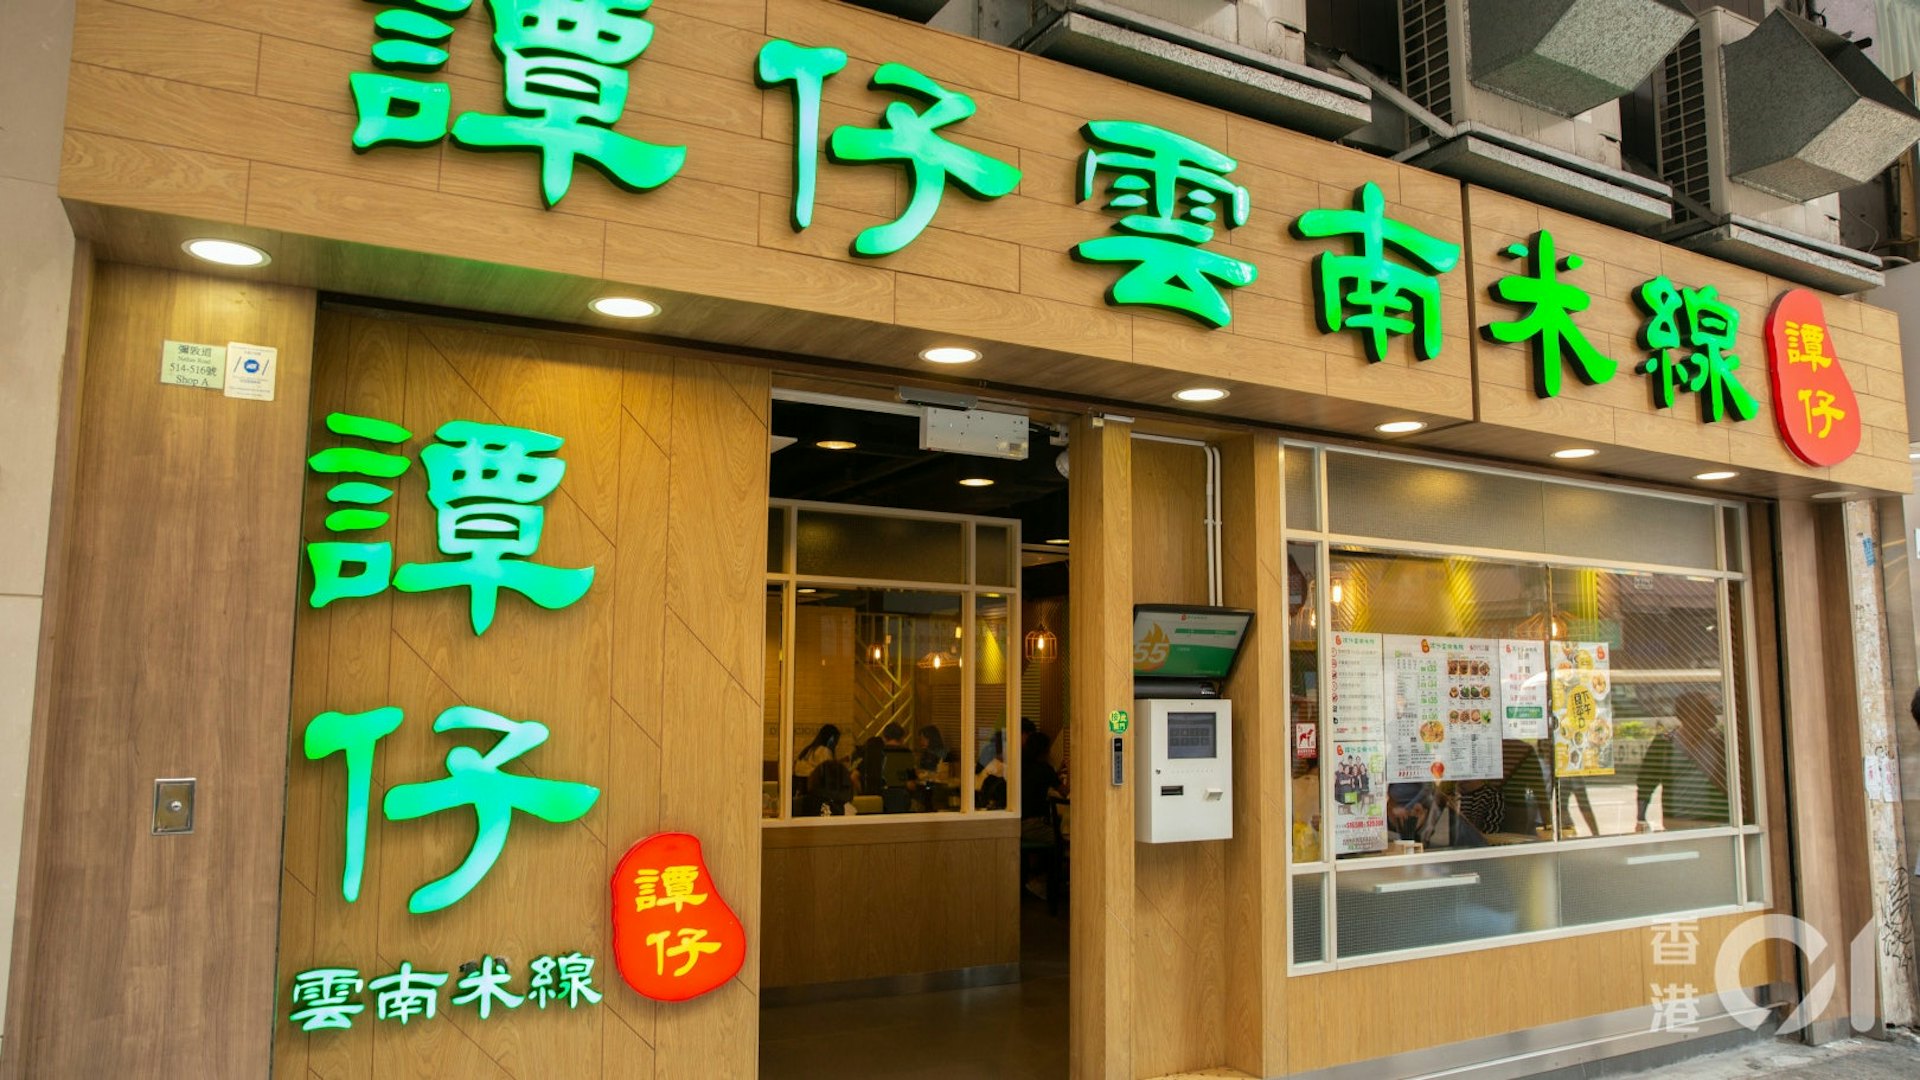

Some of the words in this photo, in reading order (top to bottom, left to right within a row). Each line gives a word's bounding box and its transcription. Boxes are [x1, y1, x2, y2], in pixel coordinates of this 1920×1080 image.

[348, 0, 1760, 423] 譚仔雲南米線
[176, 375, 199, 387] Shop
[201, 378, 209, 386] A
[1784, 320, 1845, 439] 譚仔
[303, 412, 601, 914] 譚仔
[635, 866, 722, 976] 譚仔
[290, 953, 603, 1031] 雲南米線
